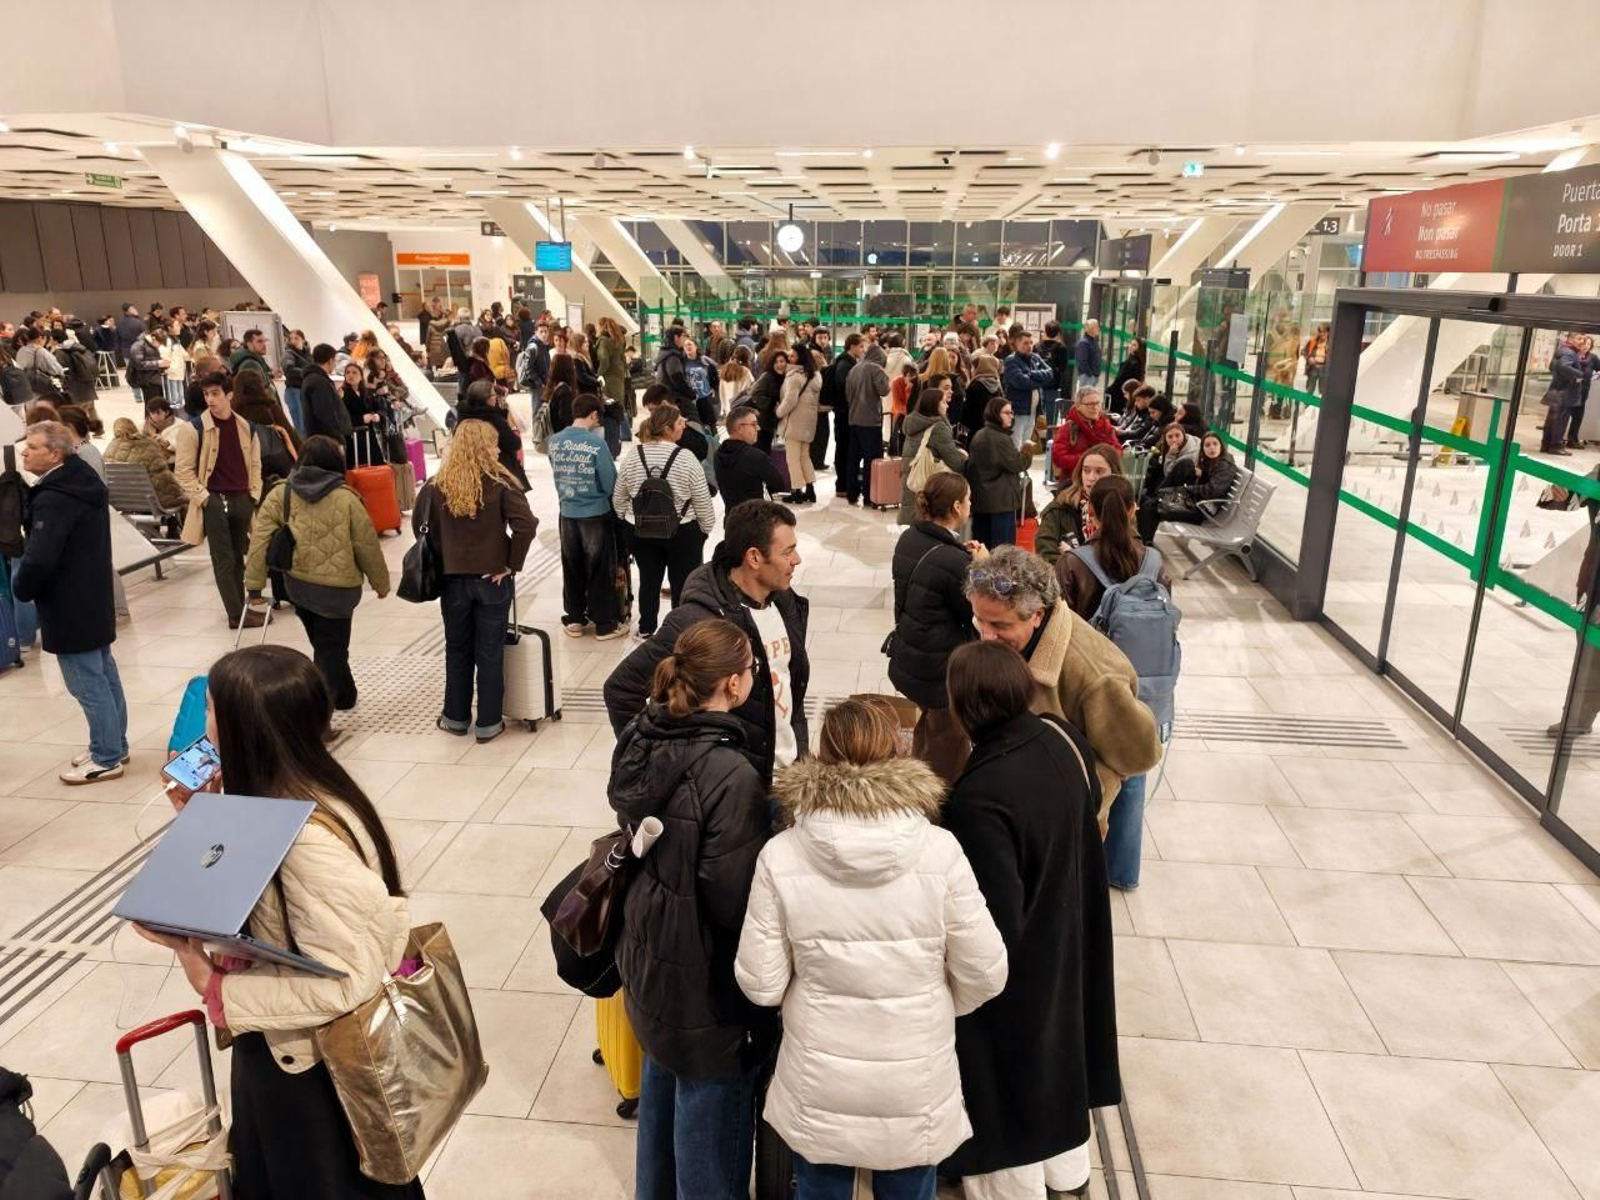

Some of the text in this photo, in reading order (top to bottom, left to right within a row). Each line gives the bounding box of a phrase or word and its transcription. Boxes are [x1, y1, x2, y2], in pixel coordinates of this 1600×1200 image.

[1562, 180, 1600, 203] Puerta
[1421, 201, 1457, 220] No pasar
[1322, 220, 1338, 233] 1.3
[1557, 213, 1592, 233] Porta
[1418, 225, 1434, 241] Non
[1553, 244, 1577, 257] DOOR
